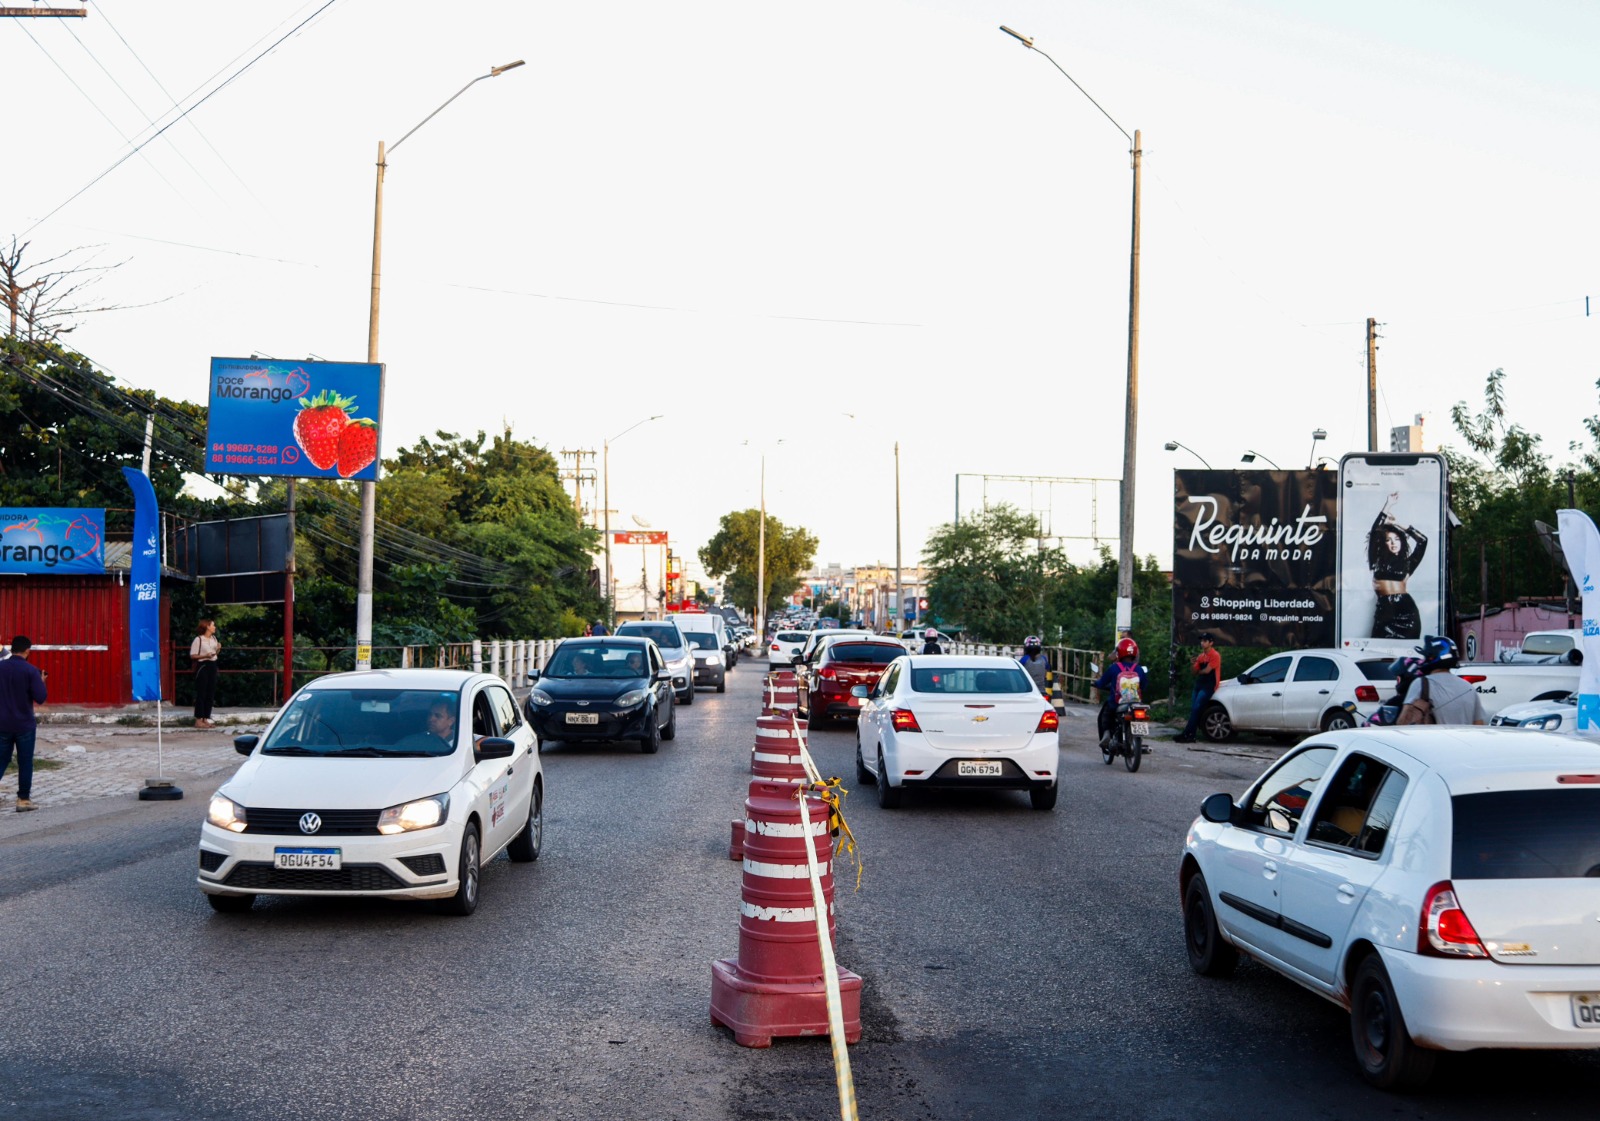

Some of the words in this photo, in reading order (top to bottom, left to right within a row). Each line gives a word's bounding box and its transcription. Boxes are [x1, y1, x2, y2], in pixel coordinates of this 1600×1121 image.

[216, 385, 292, 403] Morango
[213, 443, 224, 451] 84
[227, 444, 278, 454] 99687-8288
[212, 454, 223, 462] 88
[226, 455, 277, 464] 99666-5541
[1188, 496, 1327, 562] Requinte
[0, 544, 75, 567] rango
[1240, 549, 1260, 560] DA
[1265, 549, 1312, 560] MODA
[1213, 598, 1261, 609] Shopping
[1264, 599, 1315, 608] Liberdade
[1269, 615, 1324, 623] requinte_moda
[1476, 686, 1497, 694] 4x4
